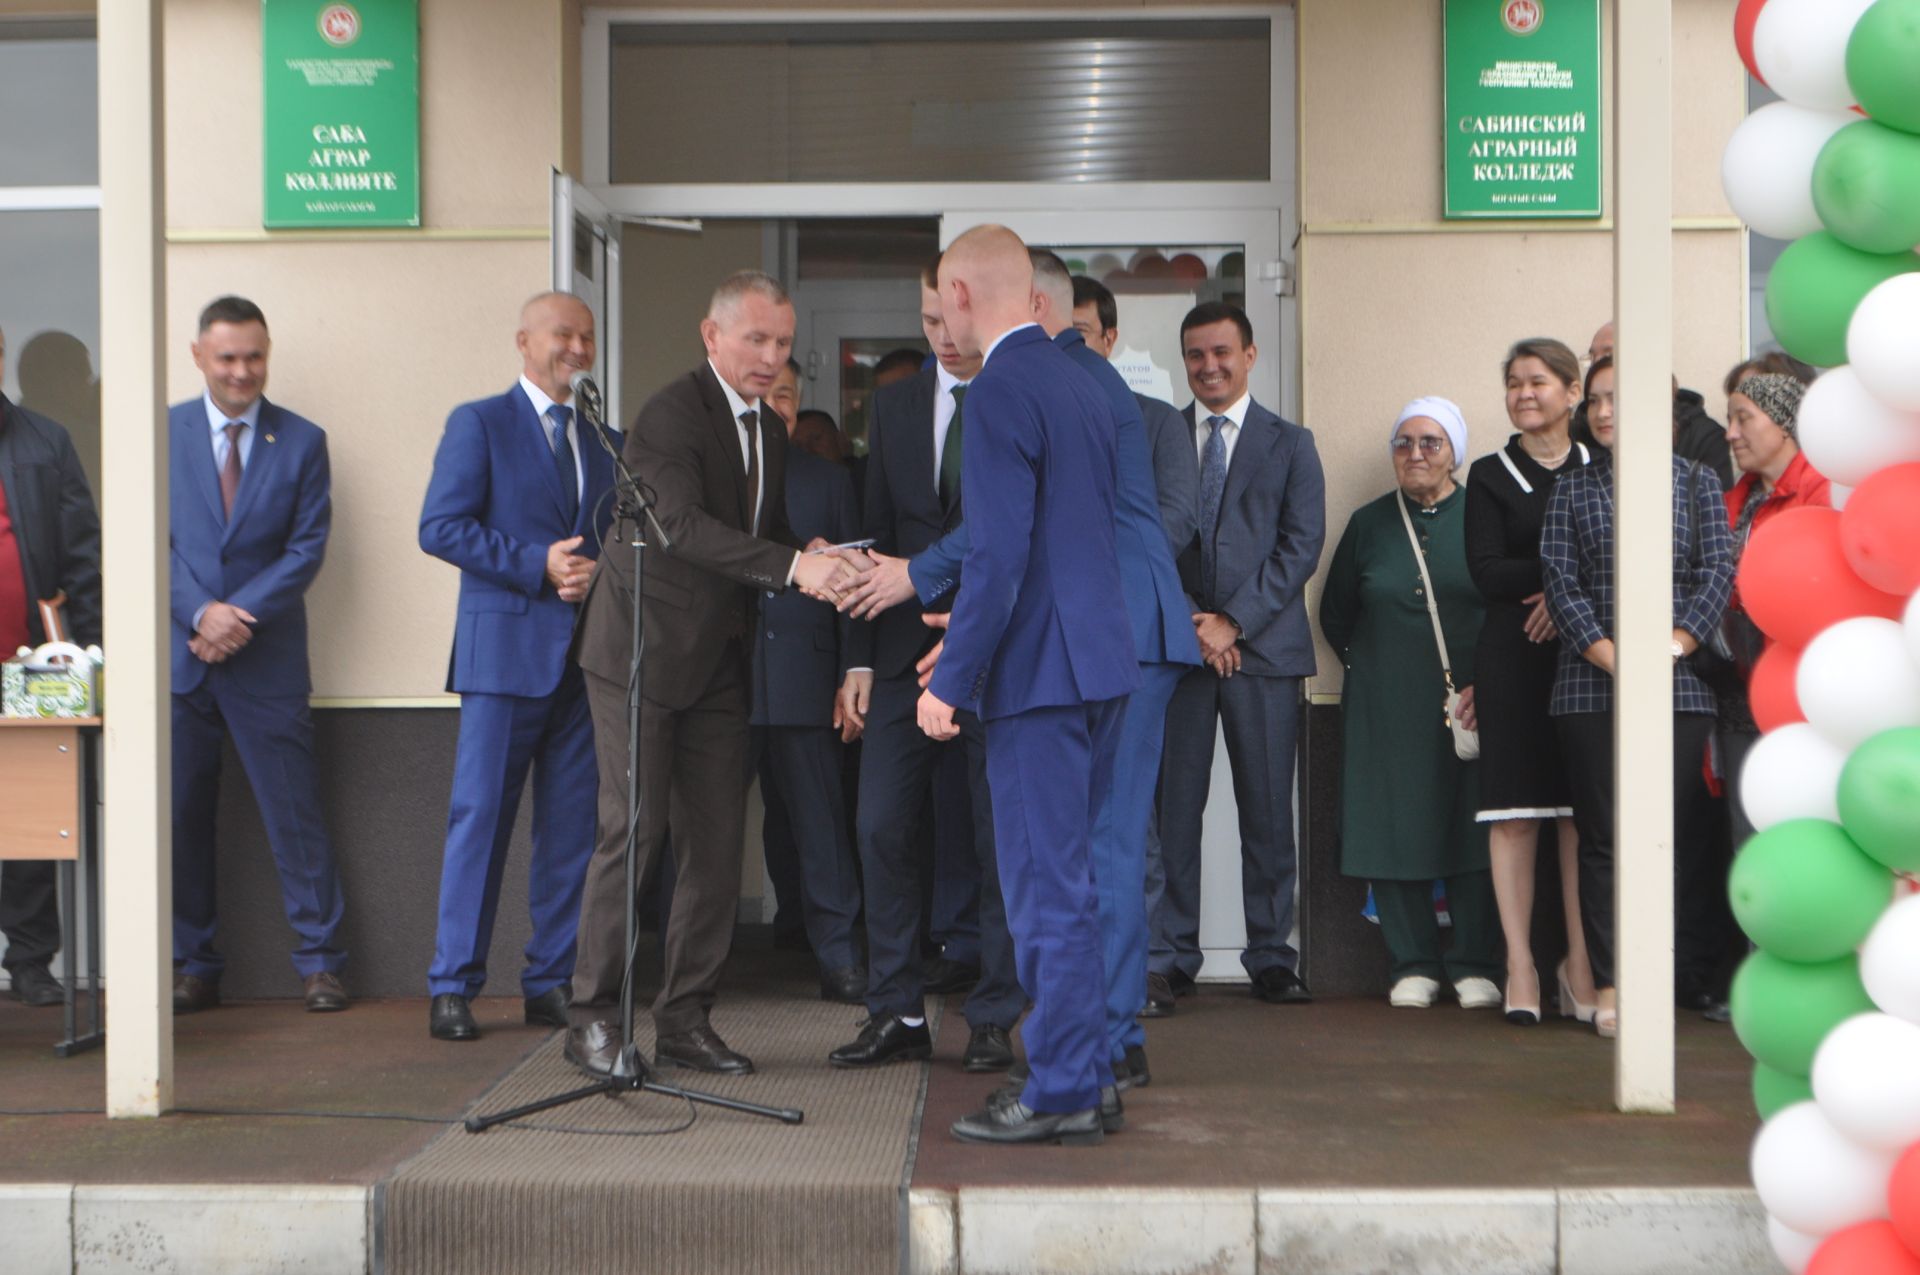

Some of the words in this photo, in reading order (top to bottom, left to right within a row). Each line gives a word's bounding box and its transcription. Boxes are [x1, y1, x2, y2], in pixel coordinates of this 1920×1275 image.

[1531, 79, 1573, 89] ТАТАРСТАН
[1459, 111, 1586, 133] САБИНСКИЙ
[312, 124, 367, 143] САБА
[1469, 136, 1577, 158] АГРАРНЫЙ
[309, 148, 371, 167] АГРАР
[1473, 163, 1575, 183] КОЛЛЕДЖ
[1531, 193, 1557, 204] САБЫ
